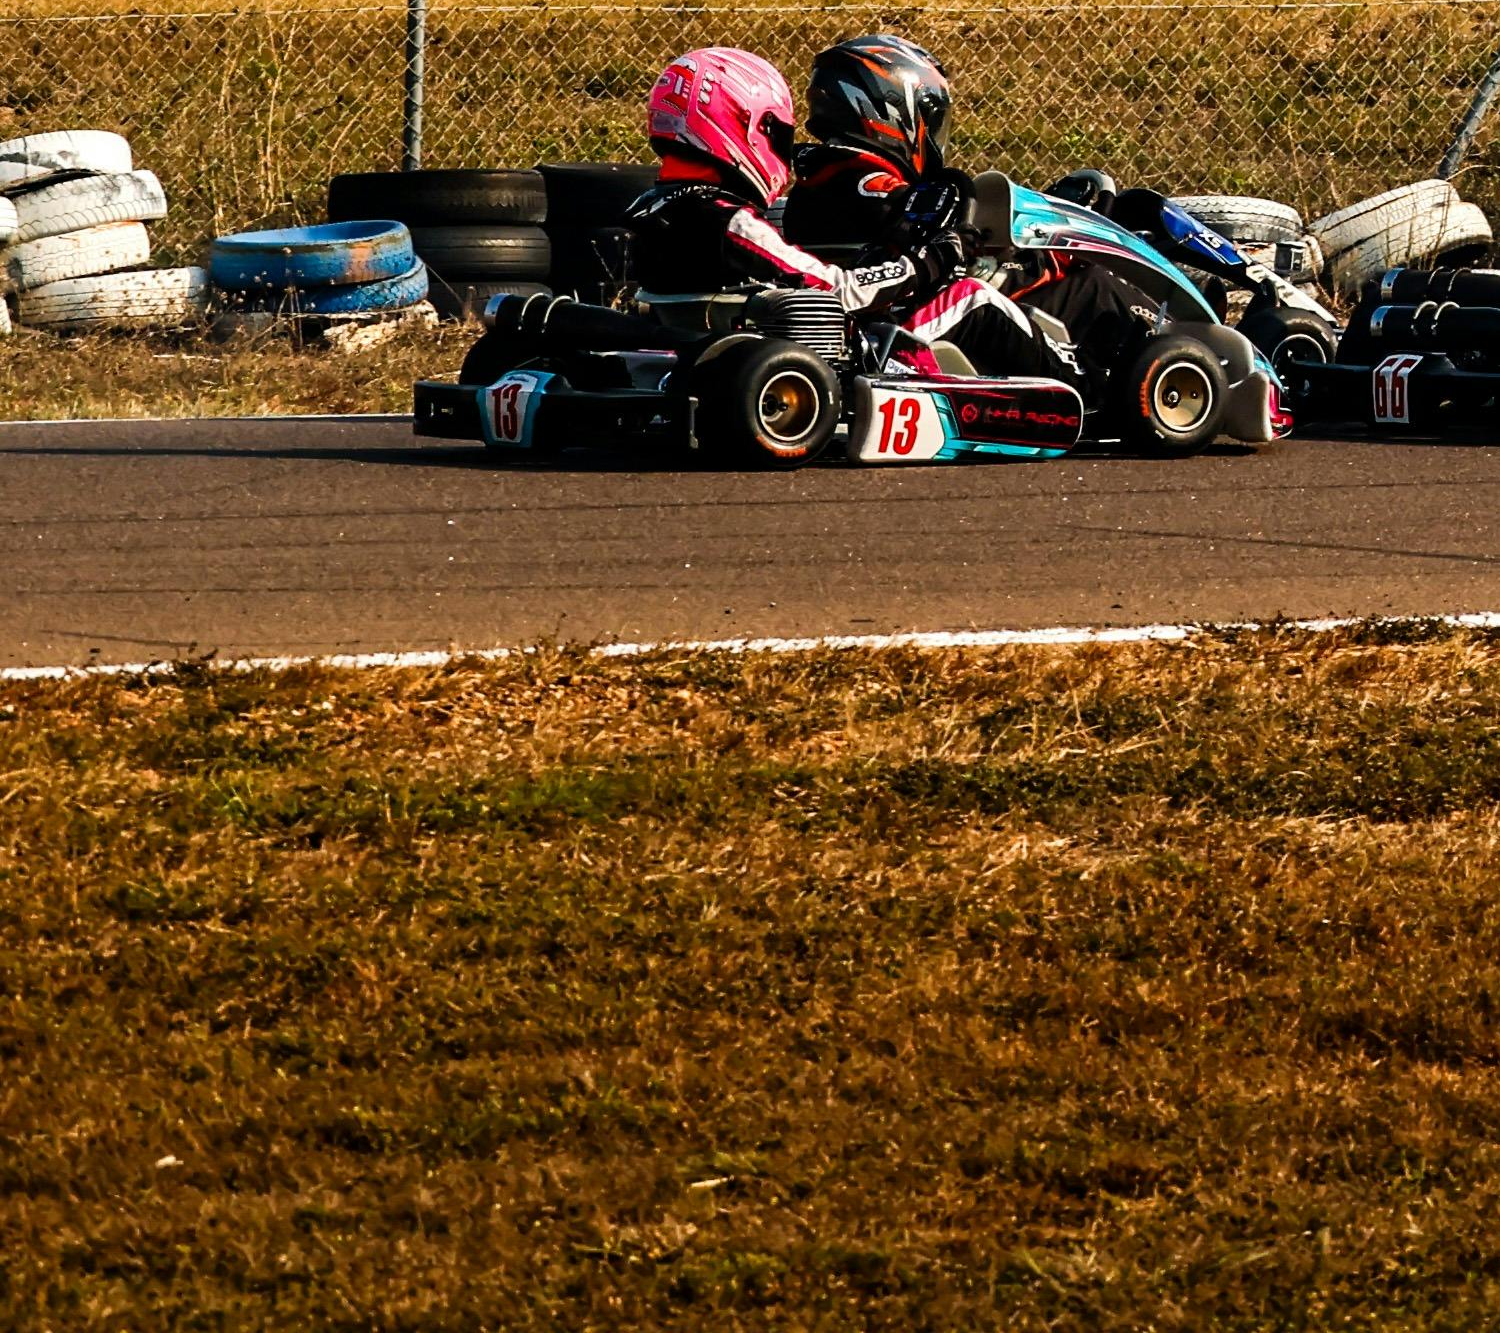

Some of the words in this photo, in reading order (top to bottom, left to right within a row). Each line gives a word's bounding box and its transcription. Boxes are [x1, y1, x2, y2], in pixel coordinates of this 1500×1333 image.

[491, 383, 523, 440] 13
[1375, 357, 1417, 418] 66
[878, 397, 921, 455] 13
